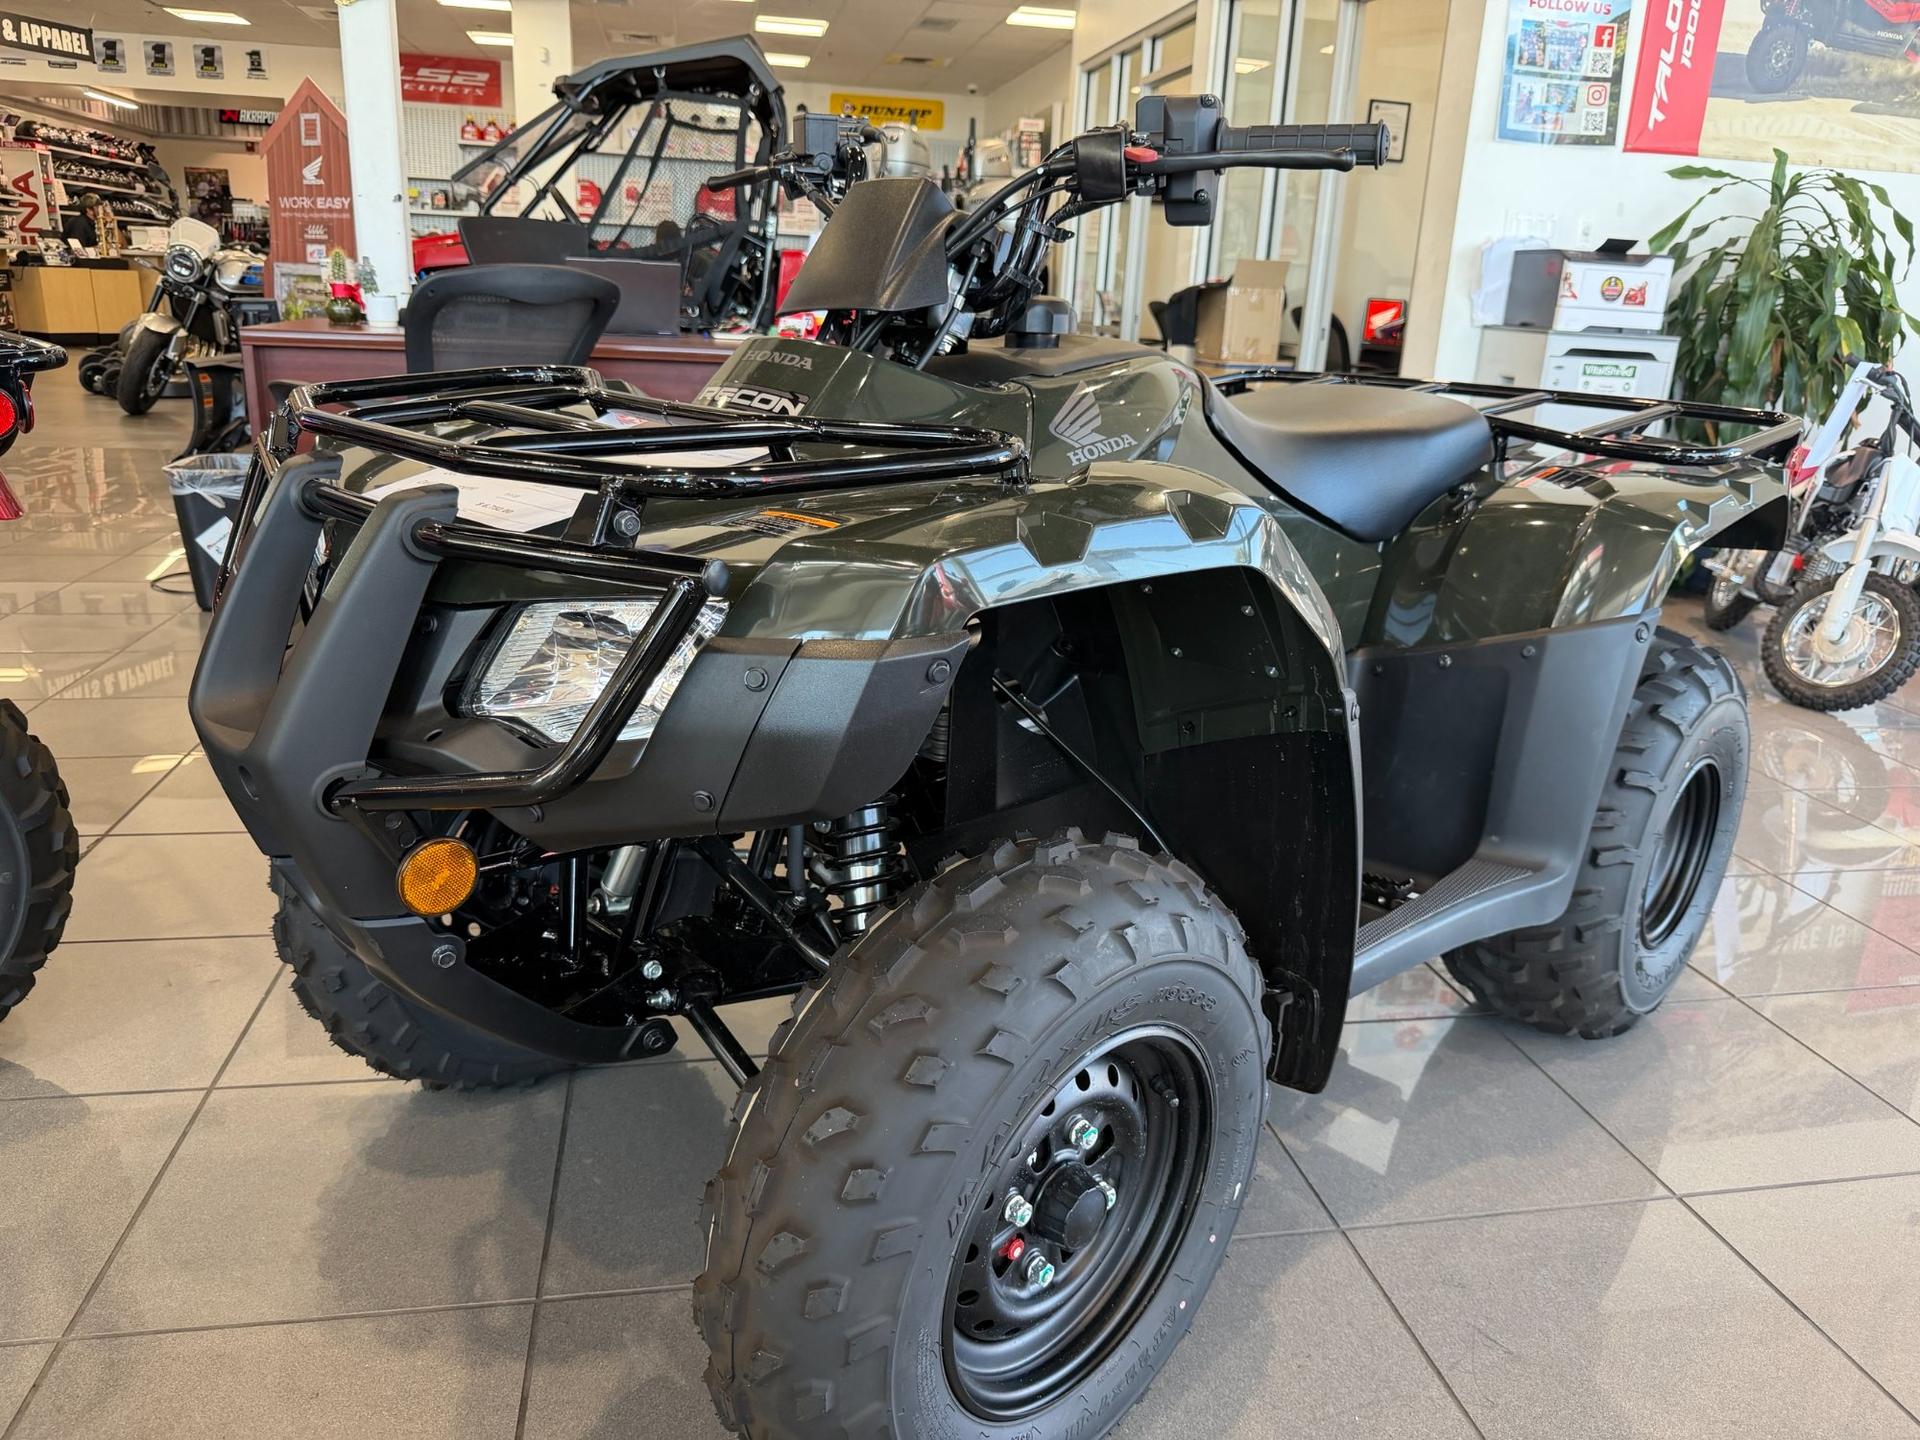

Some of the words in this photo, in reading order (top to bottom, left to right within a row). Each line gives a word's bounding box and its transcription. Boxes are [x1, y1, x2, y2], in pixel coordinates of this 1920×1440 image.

[1528, 0, 1589, 13] FOLLOW
[1592, 2, 1612, 15] US
[2, 18, 18, 42] &
[20, 21, 90, 56] APPAREL
[1877, 30, 1904, 41] HONDA
[1649, 0, 1683, 131] TALO
[860, 104, 933, 119] DUNLOP
[279, 196, 315, 209] WORK
[316, 196, 351, 209] EASY
[742, 350, 813, 371] HONDA
[697, 386, 806, 417] RECON
[1066, 433, 1139, 467] HONDA
